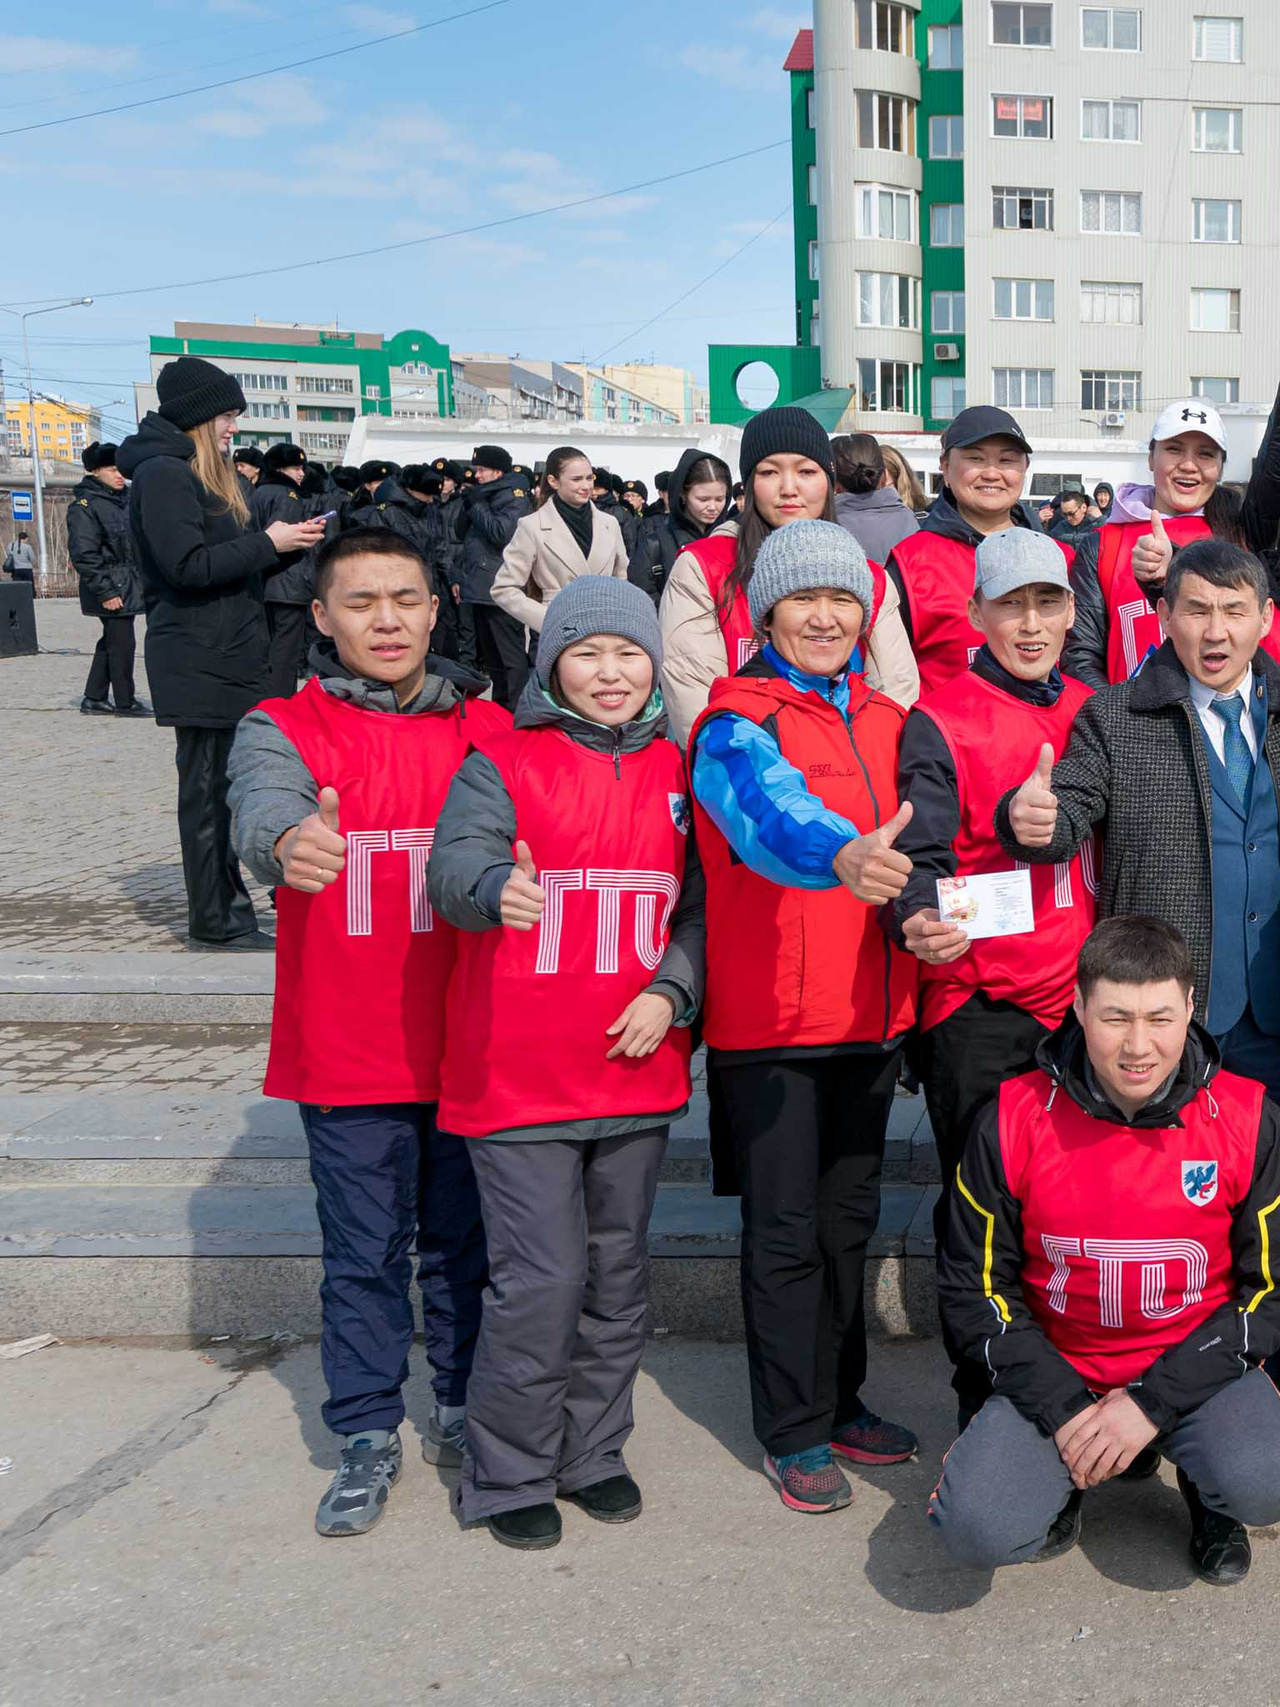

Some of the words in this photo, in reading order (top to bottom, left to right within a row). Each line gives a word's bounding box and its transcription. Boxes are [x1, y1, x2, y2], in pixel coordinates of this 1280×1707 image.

[346, 827, 436, 936] ГТ
[535, 868, 681, 974] ГТО
[1041, 1233, 1209, 1328] ГТО
